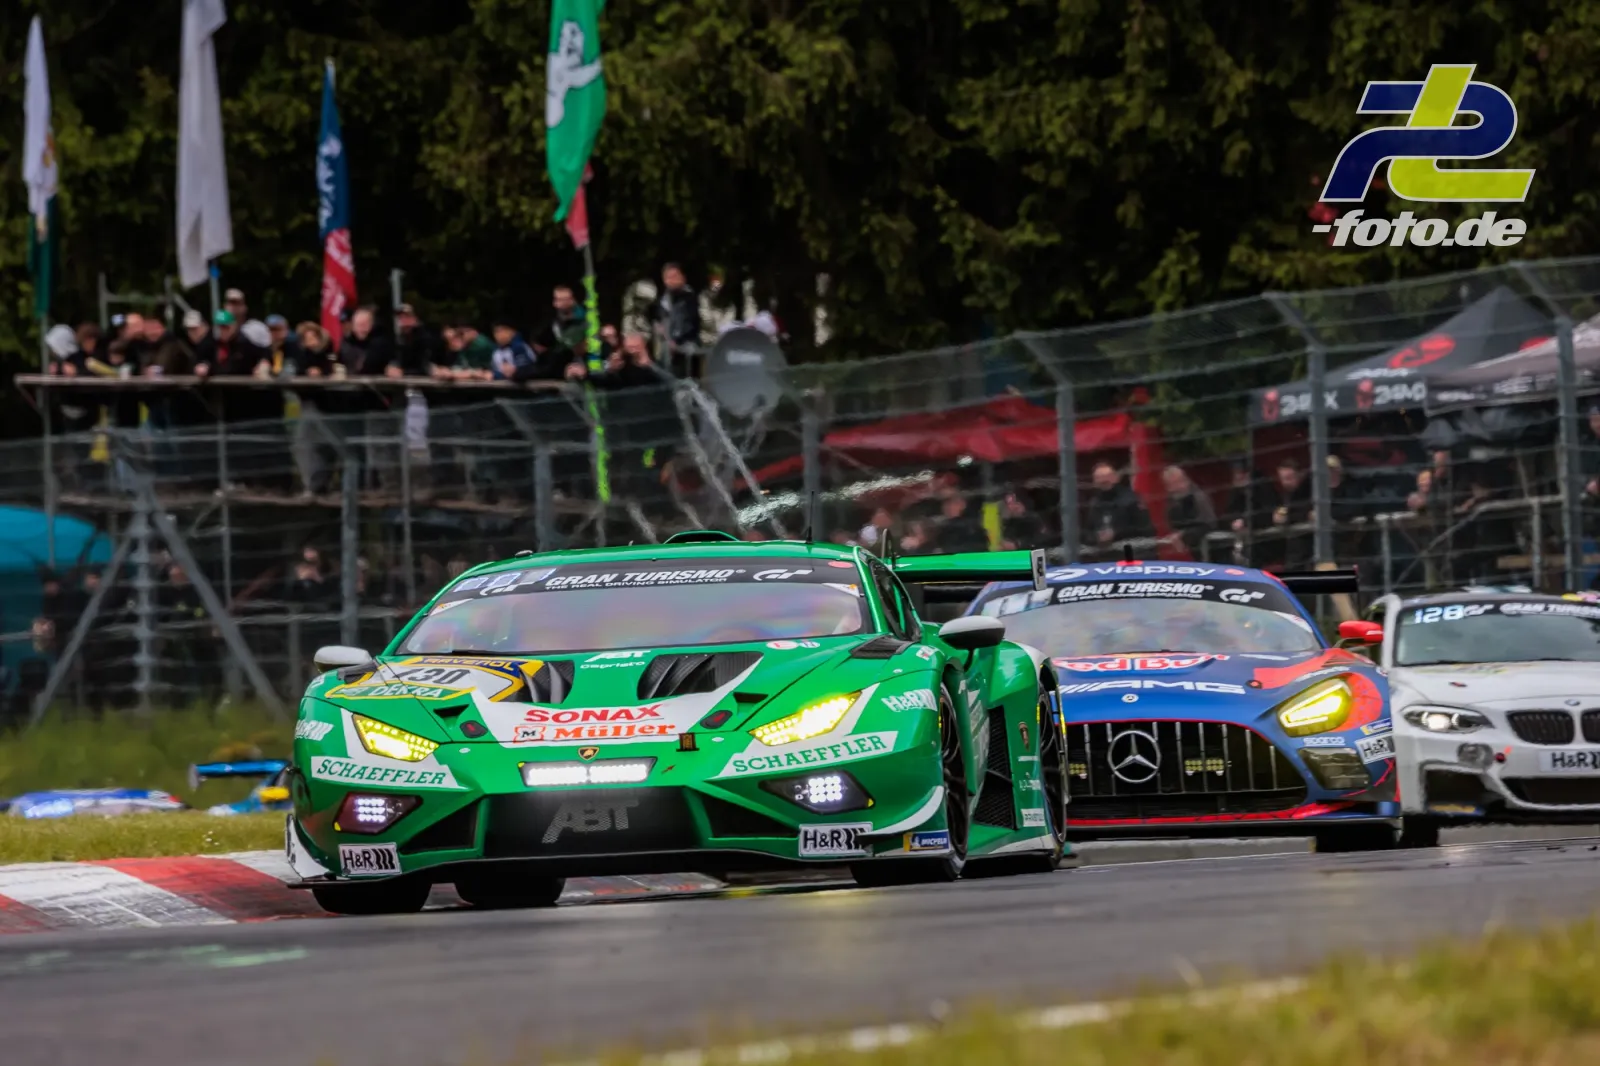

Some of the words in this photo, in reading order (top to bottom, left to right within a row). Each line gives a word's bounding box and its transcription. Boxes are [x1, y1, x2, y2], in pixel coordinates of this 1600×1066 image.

[1094, 565, 1217, 576] viaplay
[545, 572, 619, 587] GRAN
[655, 577, 727, 585] SIMULATOR
[1057, 583, 1114, 598] GRAN
[1414, 605, 1464, 624] 128
[423, 657, 515, 671] RAVENOL
[370, 683, 443, 698] DEKRA
[1087, 680, 1247, 695] AMG
[524, 704, 664, 724] SONAX
[554, 724, 676, 740] Müller
[733, 735, 887, 773] SCHAEFFLER
[1551, 752, 1590, 769] H&R
[317, 759, 447, 785] SCHAEFFLER
[542, 800, 639, 844] ABT
[803, 829, 842, 850] H&R
[342, 849, 374, 871] H&R
